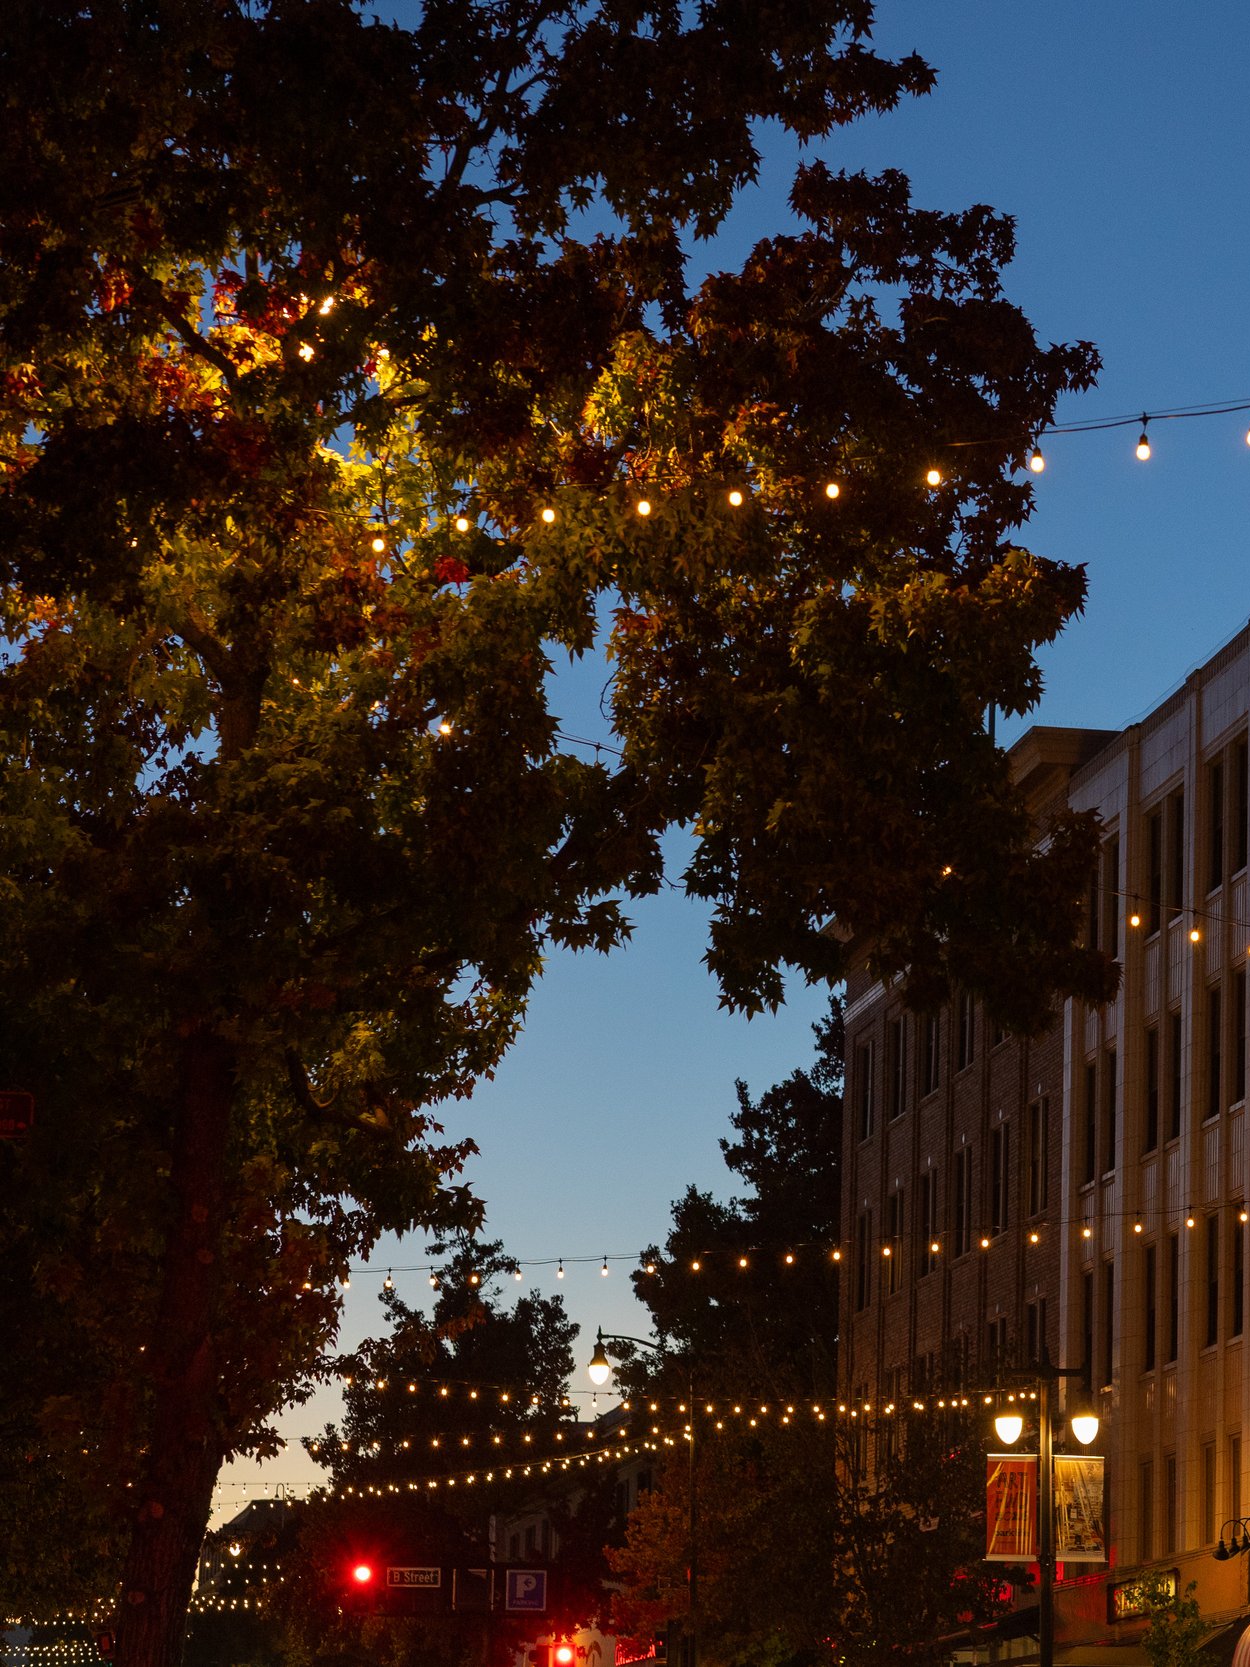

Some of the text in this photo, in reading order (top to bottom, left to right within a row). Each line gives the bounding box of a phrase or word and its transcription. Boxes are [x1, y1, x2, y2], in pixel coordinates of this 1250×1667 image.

[997, 1471, 1028, 1490] ART
[393, 1571, 434, 1583] B Street
[516, 1574, 537, 1598] P
